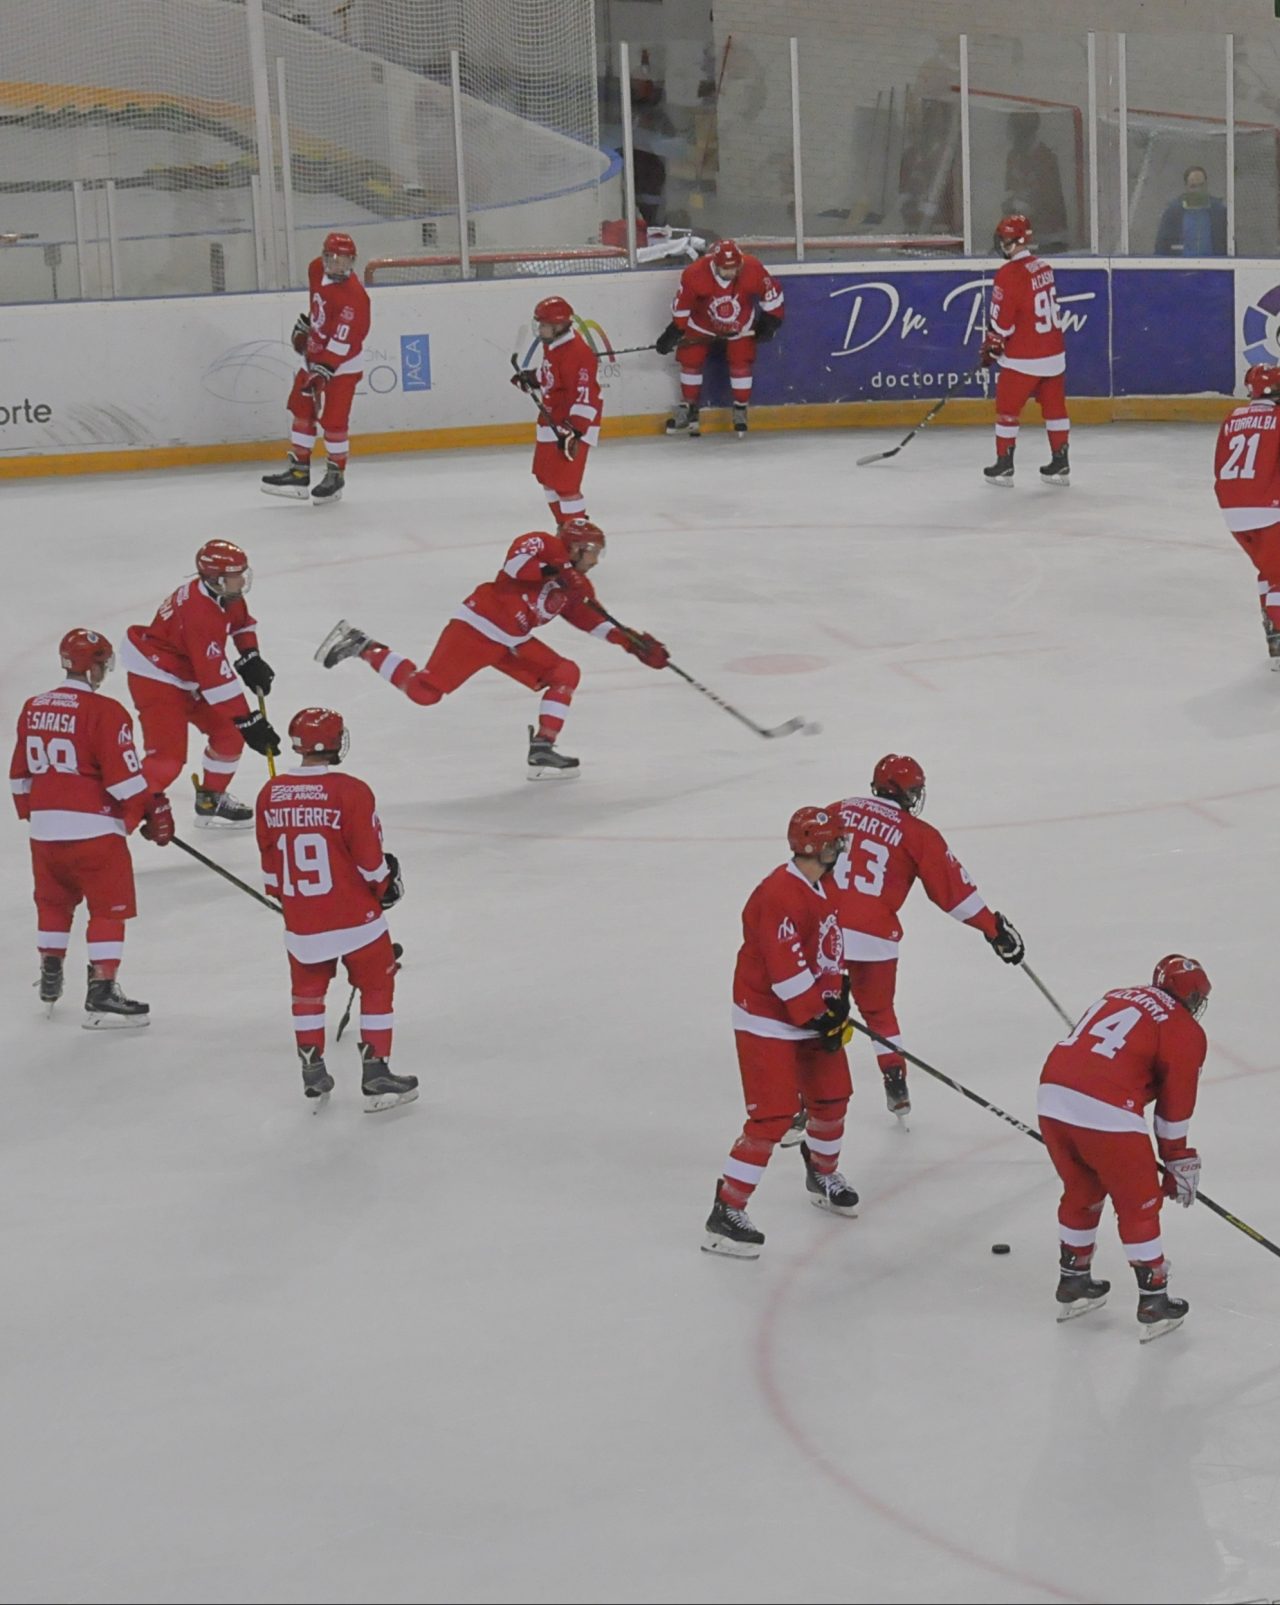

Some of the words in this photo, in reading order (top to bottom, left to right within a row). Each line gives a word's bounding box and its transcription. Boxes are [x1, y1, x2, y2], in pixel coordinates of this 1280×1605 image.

[830, 282, 929, 357] Dr.
[406, 338, 426, 386] JACA
[1219, 432, 1261, 480] 21
[839, 809, 904, 848] SCARTÍN
[276, 833, 334, 897] 19
